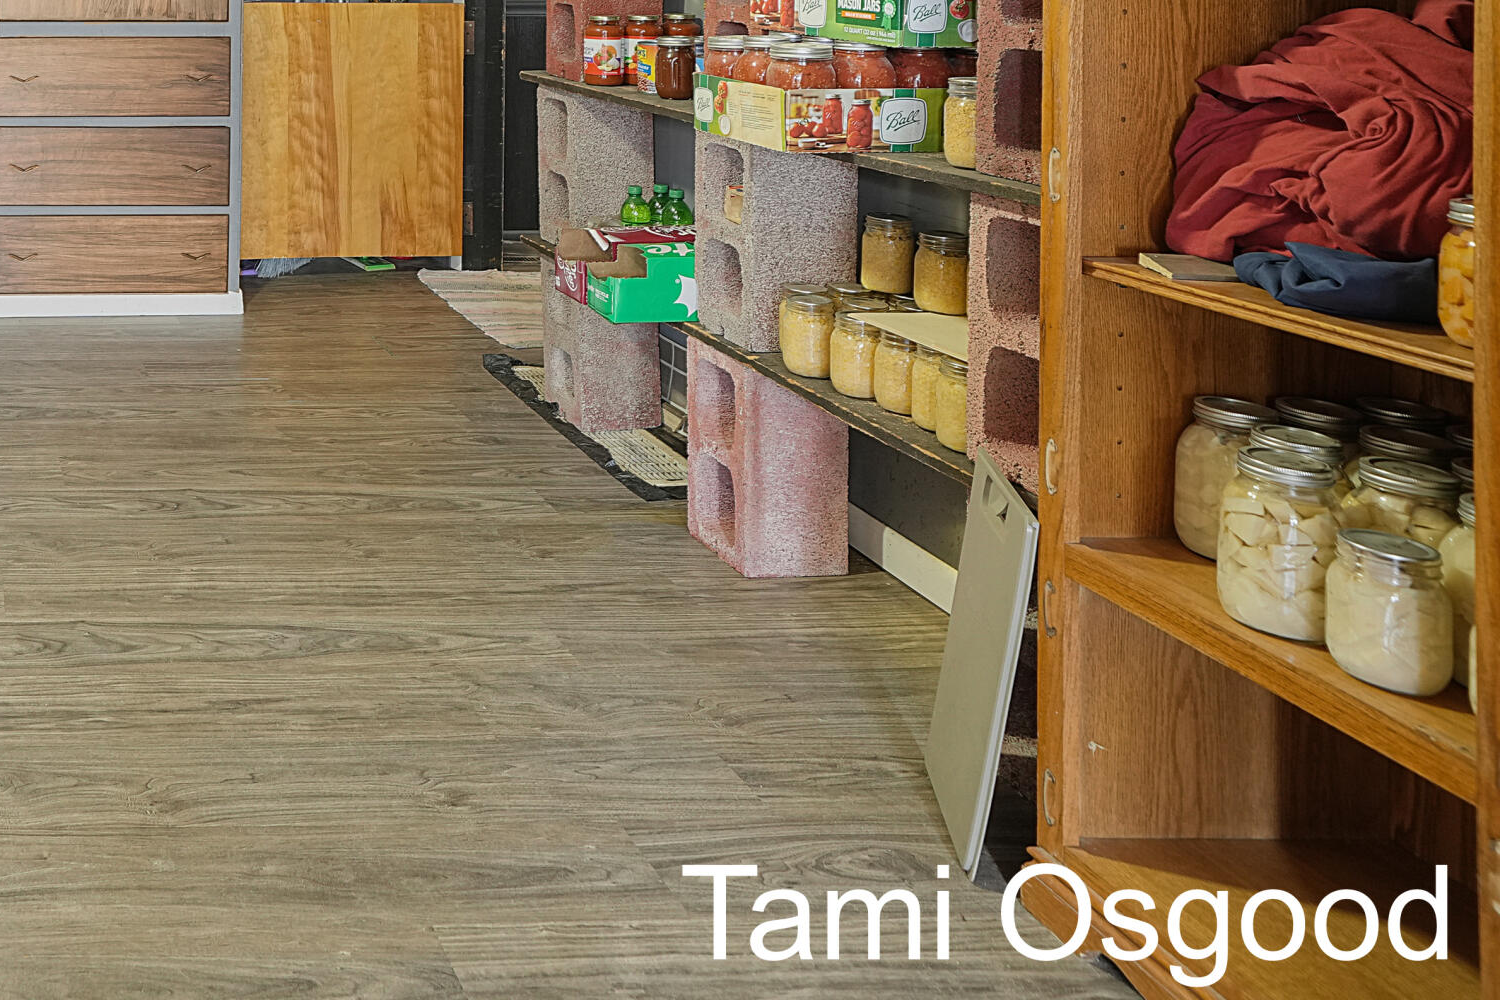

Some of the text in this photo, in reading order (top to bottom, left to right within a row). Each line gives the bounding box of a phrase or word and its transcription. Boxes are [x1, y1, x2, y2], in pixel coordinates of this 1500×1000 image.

[862, 0, 881, 13] JARS
[913, 3, 942, 22] Ball
[886, 109, 921, 132] Ball
